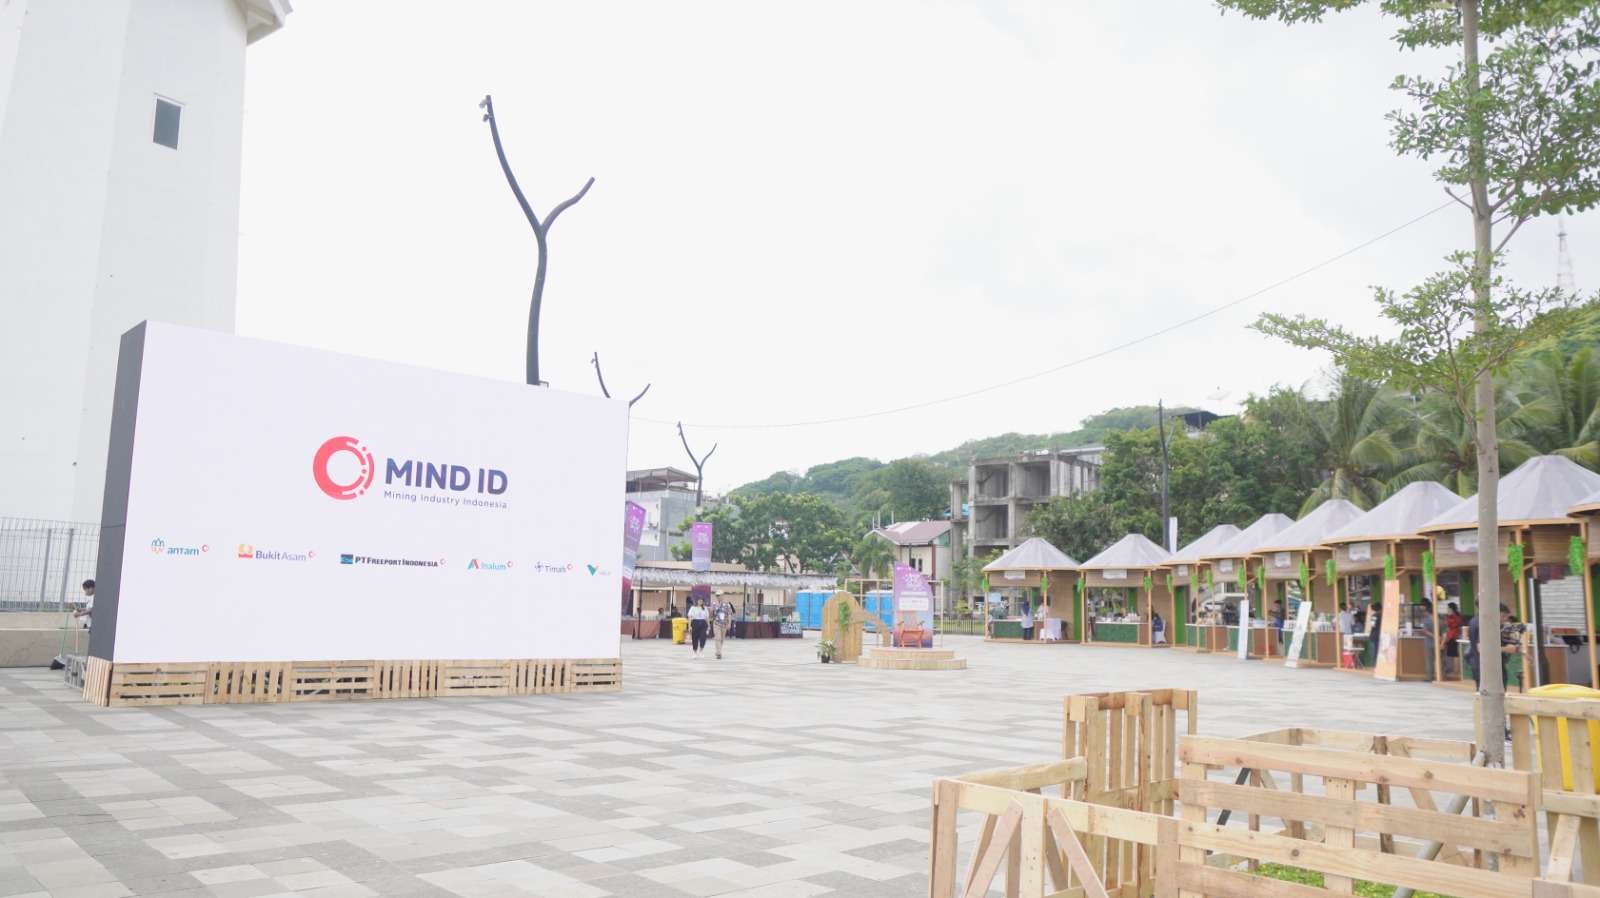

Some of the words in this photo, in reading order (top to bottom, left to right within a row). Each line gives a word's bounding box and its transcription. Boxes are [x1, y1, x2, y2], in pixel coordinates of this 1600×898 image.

[385, 458, 471, 491] MIND
[478, 468, 508, 495] ID
[383, 491, 417, 502] Mining
[420, 494, 460, 505] Industry
[463, 498, 507, 508] Indonesia
[481, 561, 506, 570] Inalum
[544, 565, 566, 573] Timah
